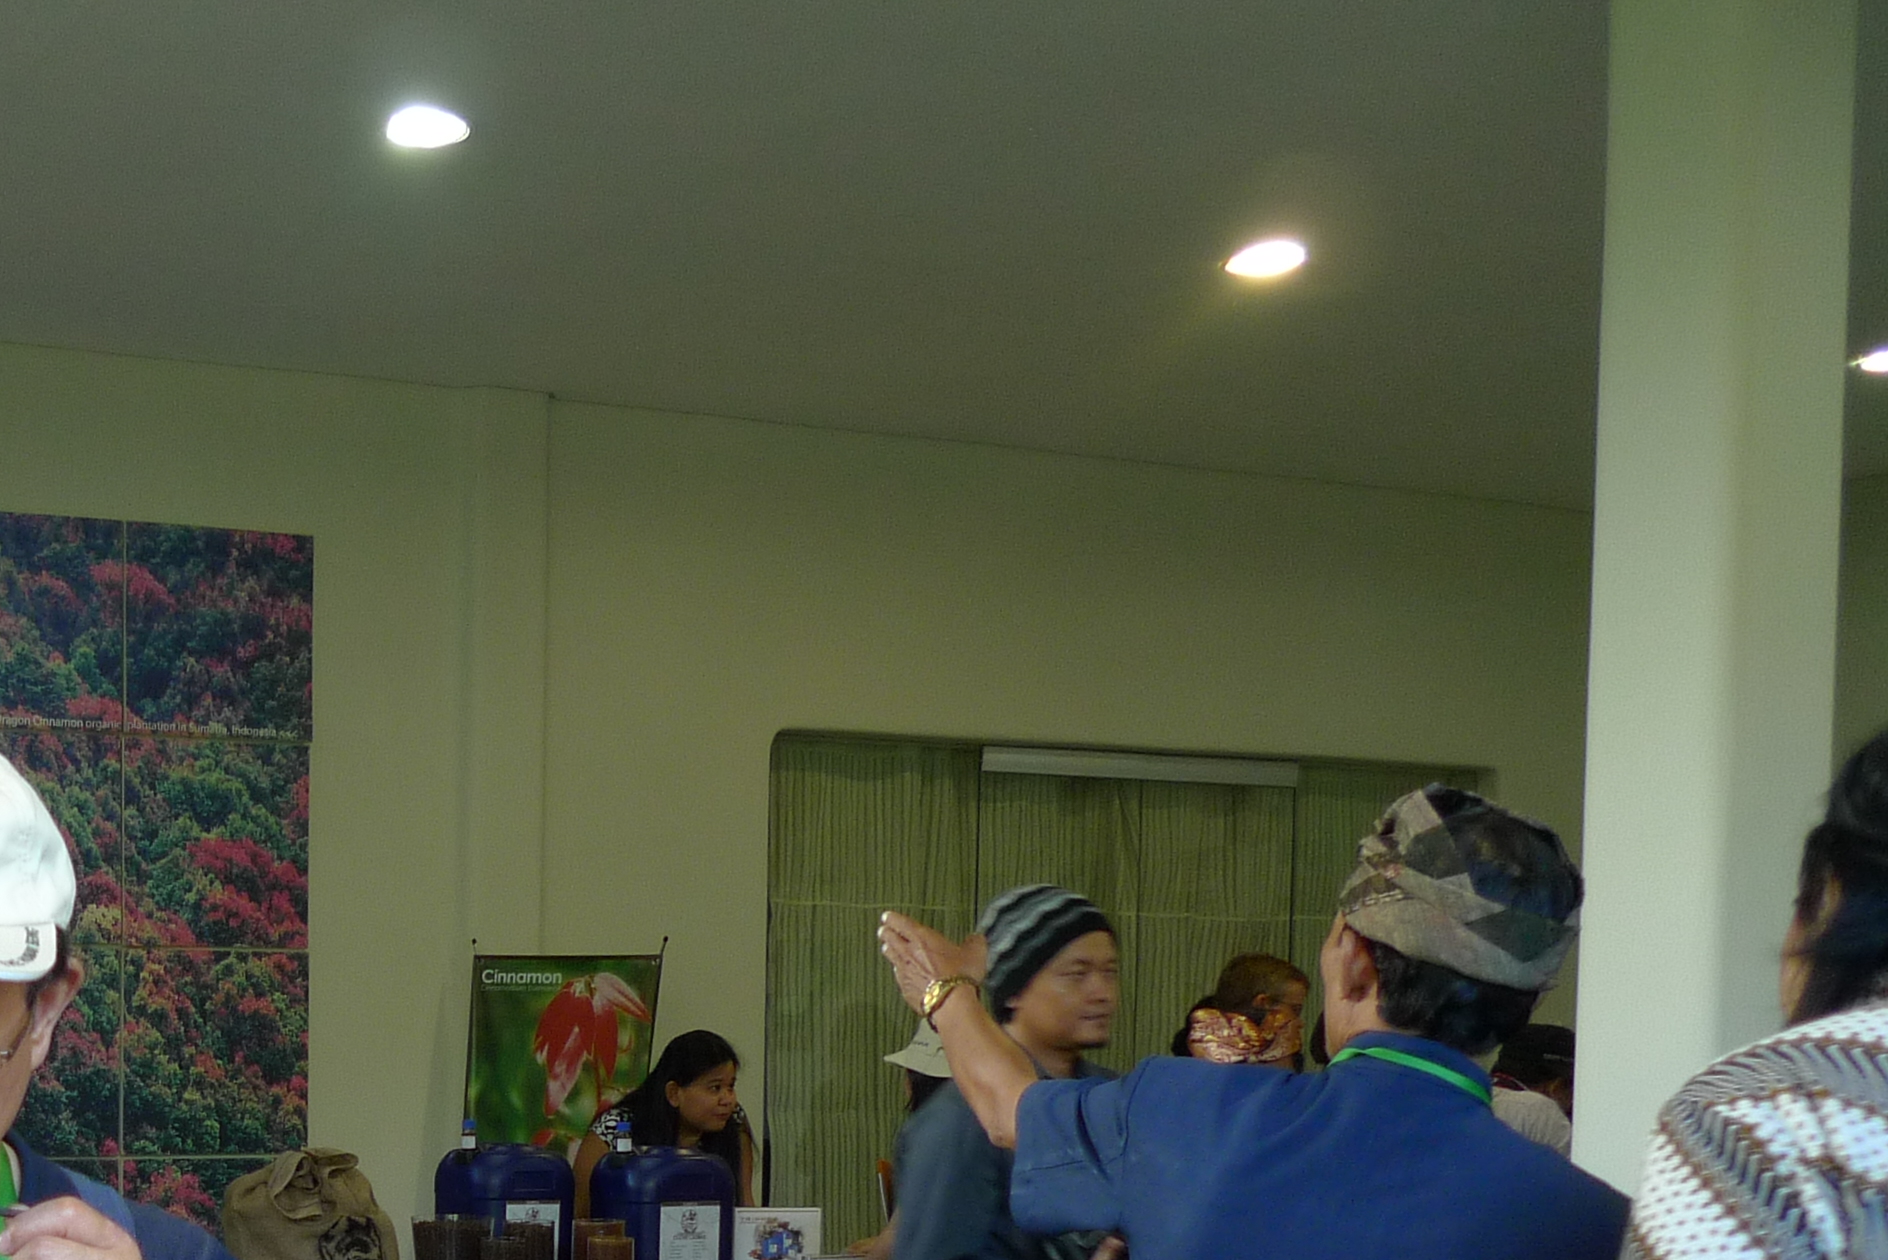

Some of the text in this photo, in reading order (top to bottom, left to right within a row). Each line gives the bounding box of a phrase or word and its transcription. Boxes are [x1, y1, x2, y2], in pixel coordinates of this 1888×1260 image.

[33, 715, 83, 728] Cinnamon
[85, 718, 120, 730] organic
[127, 719, 176, 732] plantation
[232, 723, 277, 738] Indonesia
[481, 968, 563, 985] Cinnamon
